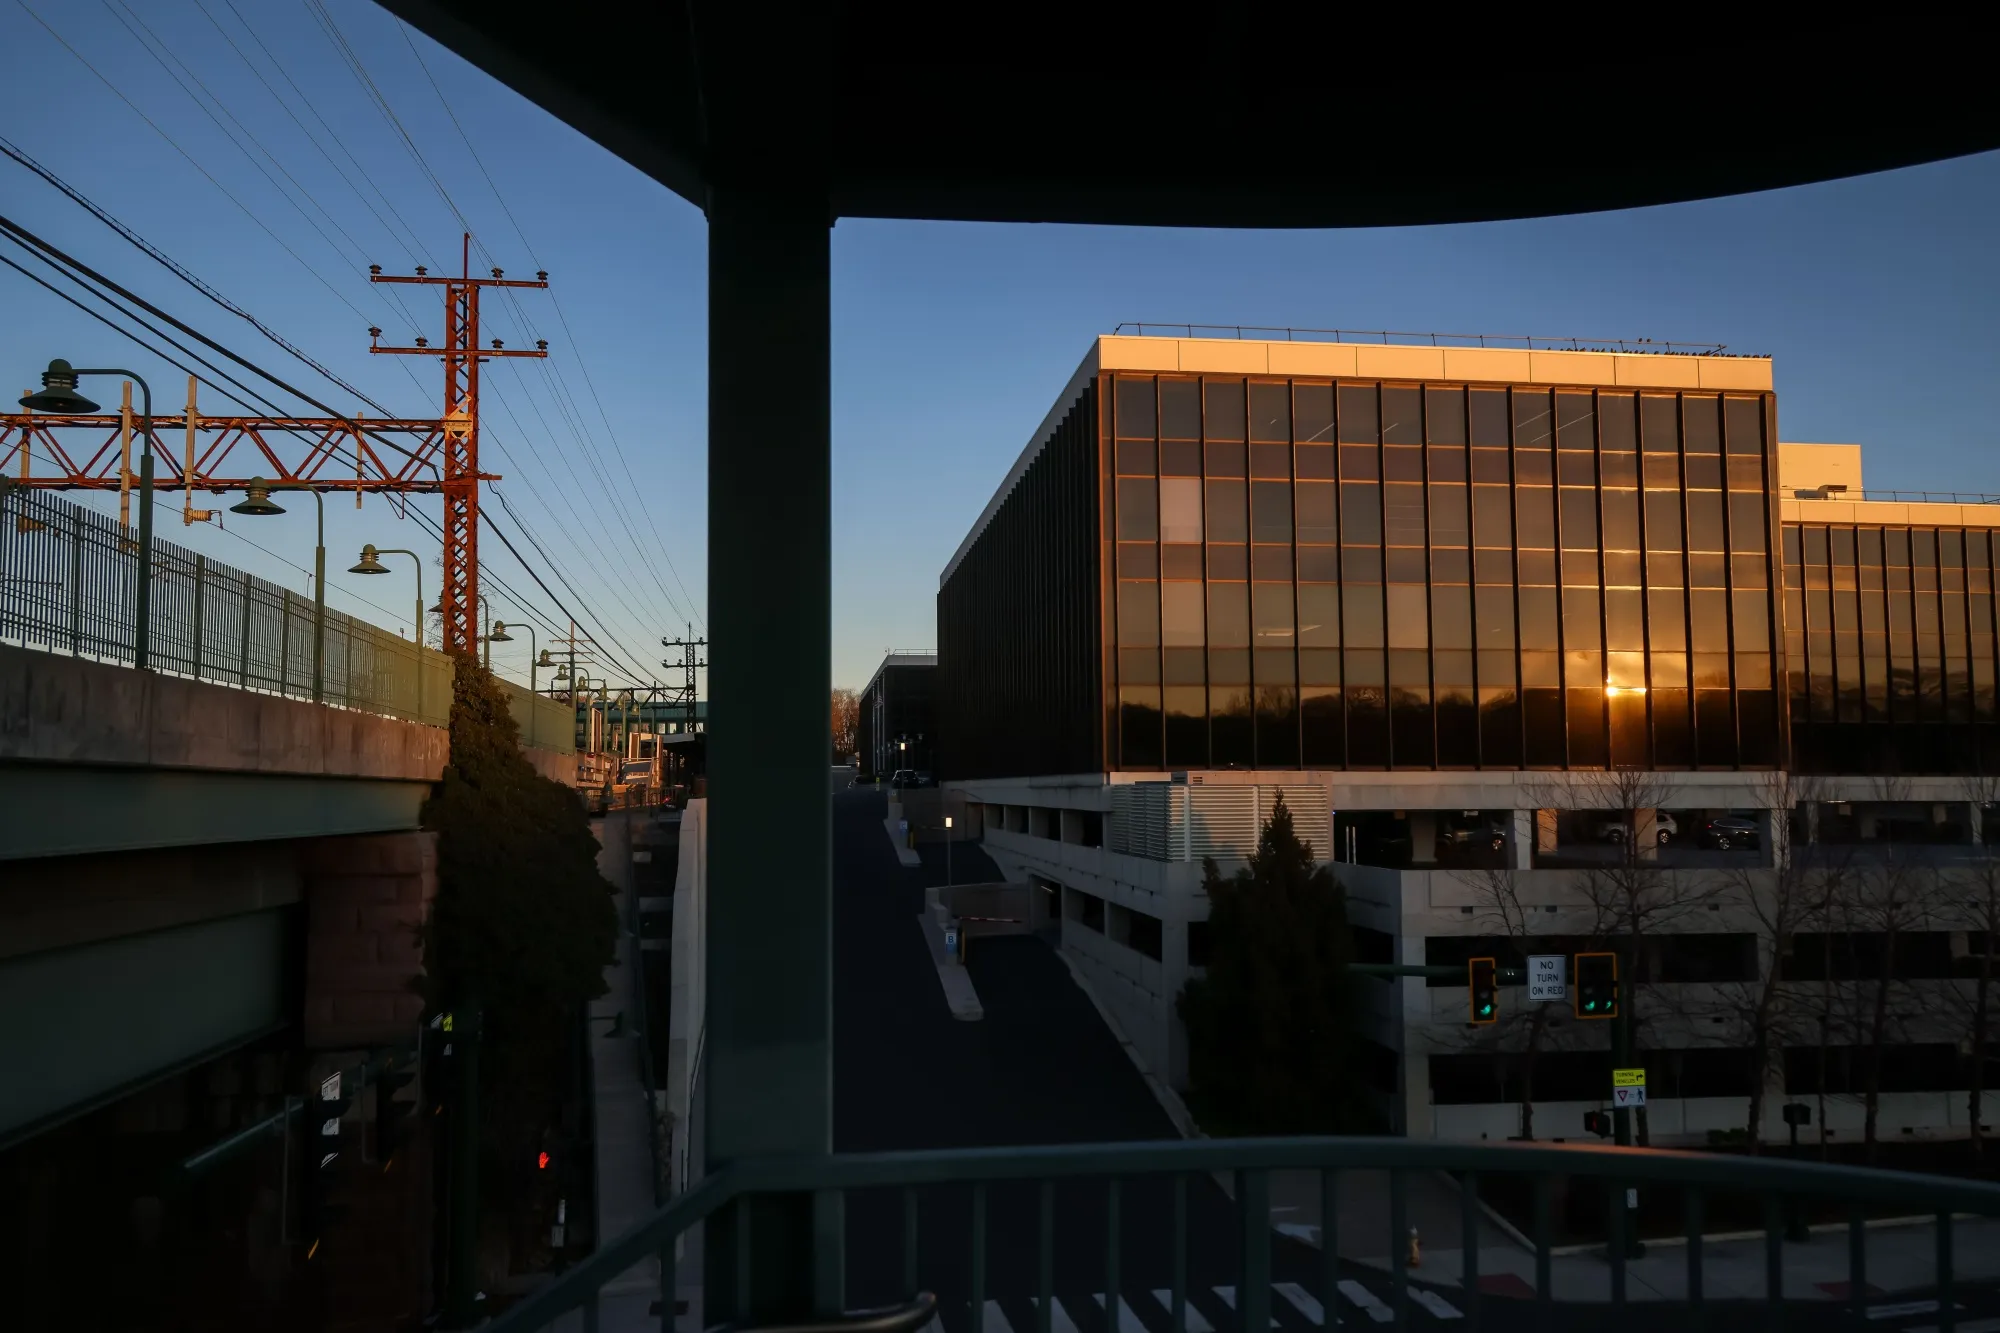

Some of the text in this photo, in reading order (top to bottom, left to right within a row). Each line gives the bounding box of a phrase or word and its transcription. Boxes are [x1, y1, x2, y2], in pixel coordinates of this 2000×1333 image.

[948, 935, 954, 943] B
[1540, 961, 1554, 970] NO
[1536, 973, 1559, 982] TURN
[1532, 986, 1563, 995] ON RED
